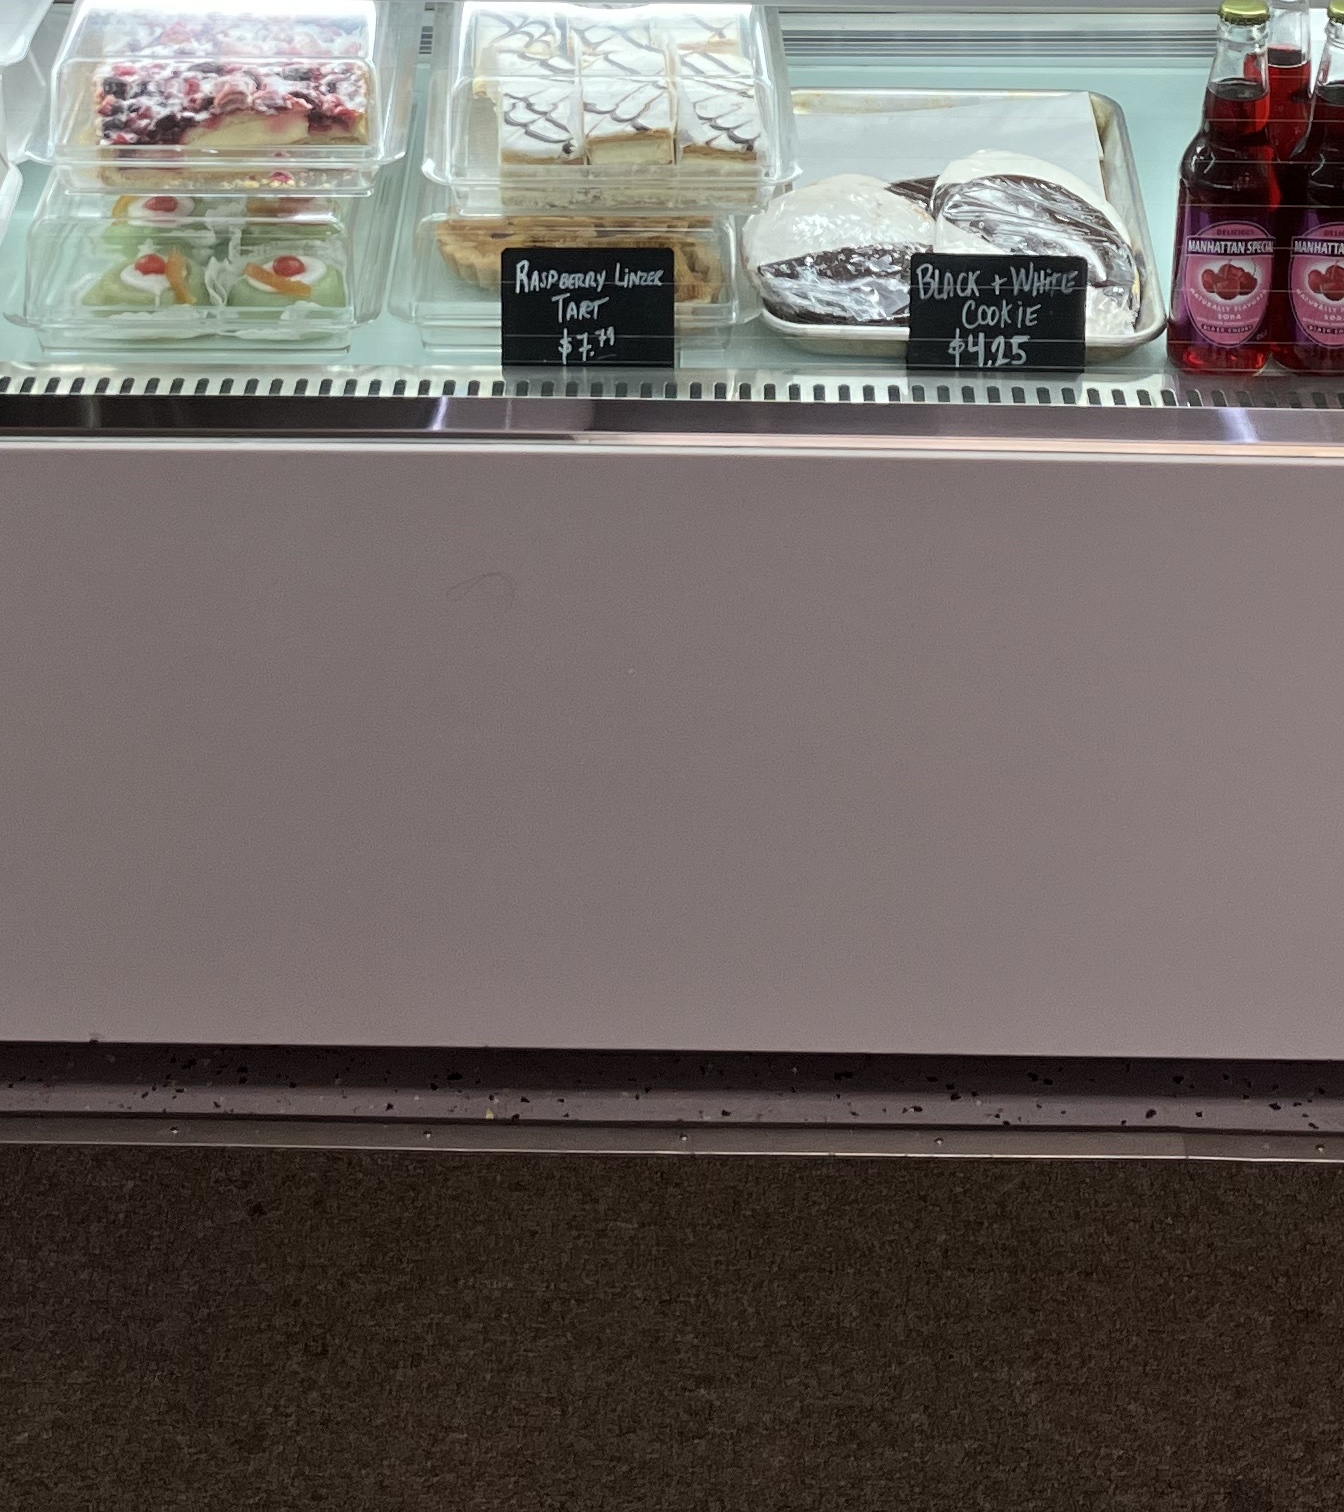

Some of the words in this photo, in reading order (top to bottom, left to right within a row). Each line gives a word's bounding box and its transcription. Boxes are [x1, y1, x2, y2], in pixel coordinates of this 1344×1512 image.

[1188, 240, 1245, 254] MANHATTAN
[516, 259, 608, 292] RASPBERRY
[917, 264, 982, 299] BLACK
[551, 295, 610, 323] TART
[948, 328, 1030, 367] $4.25
